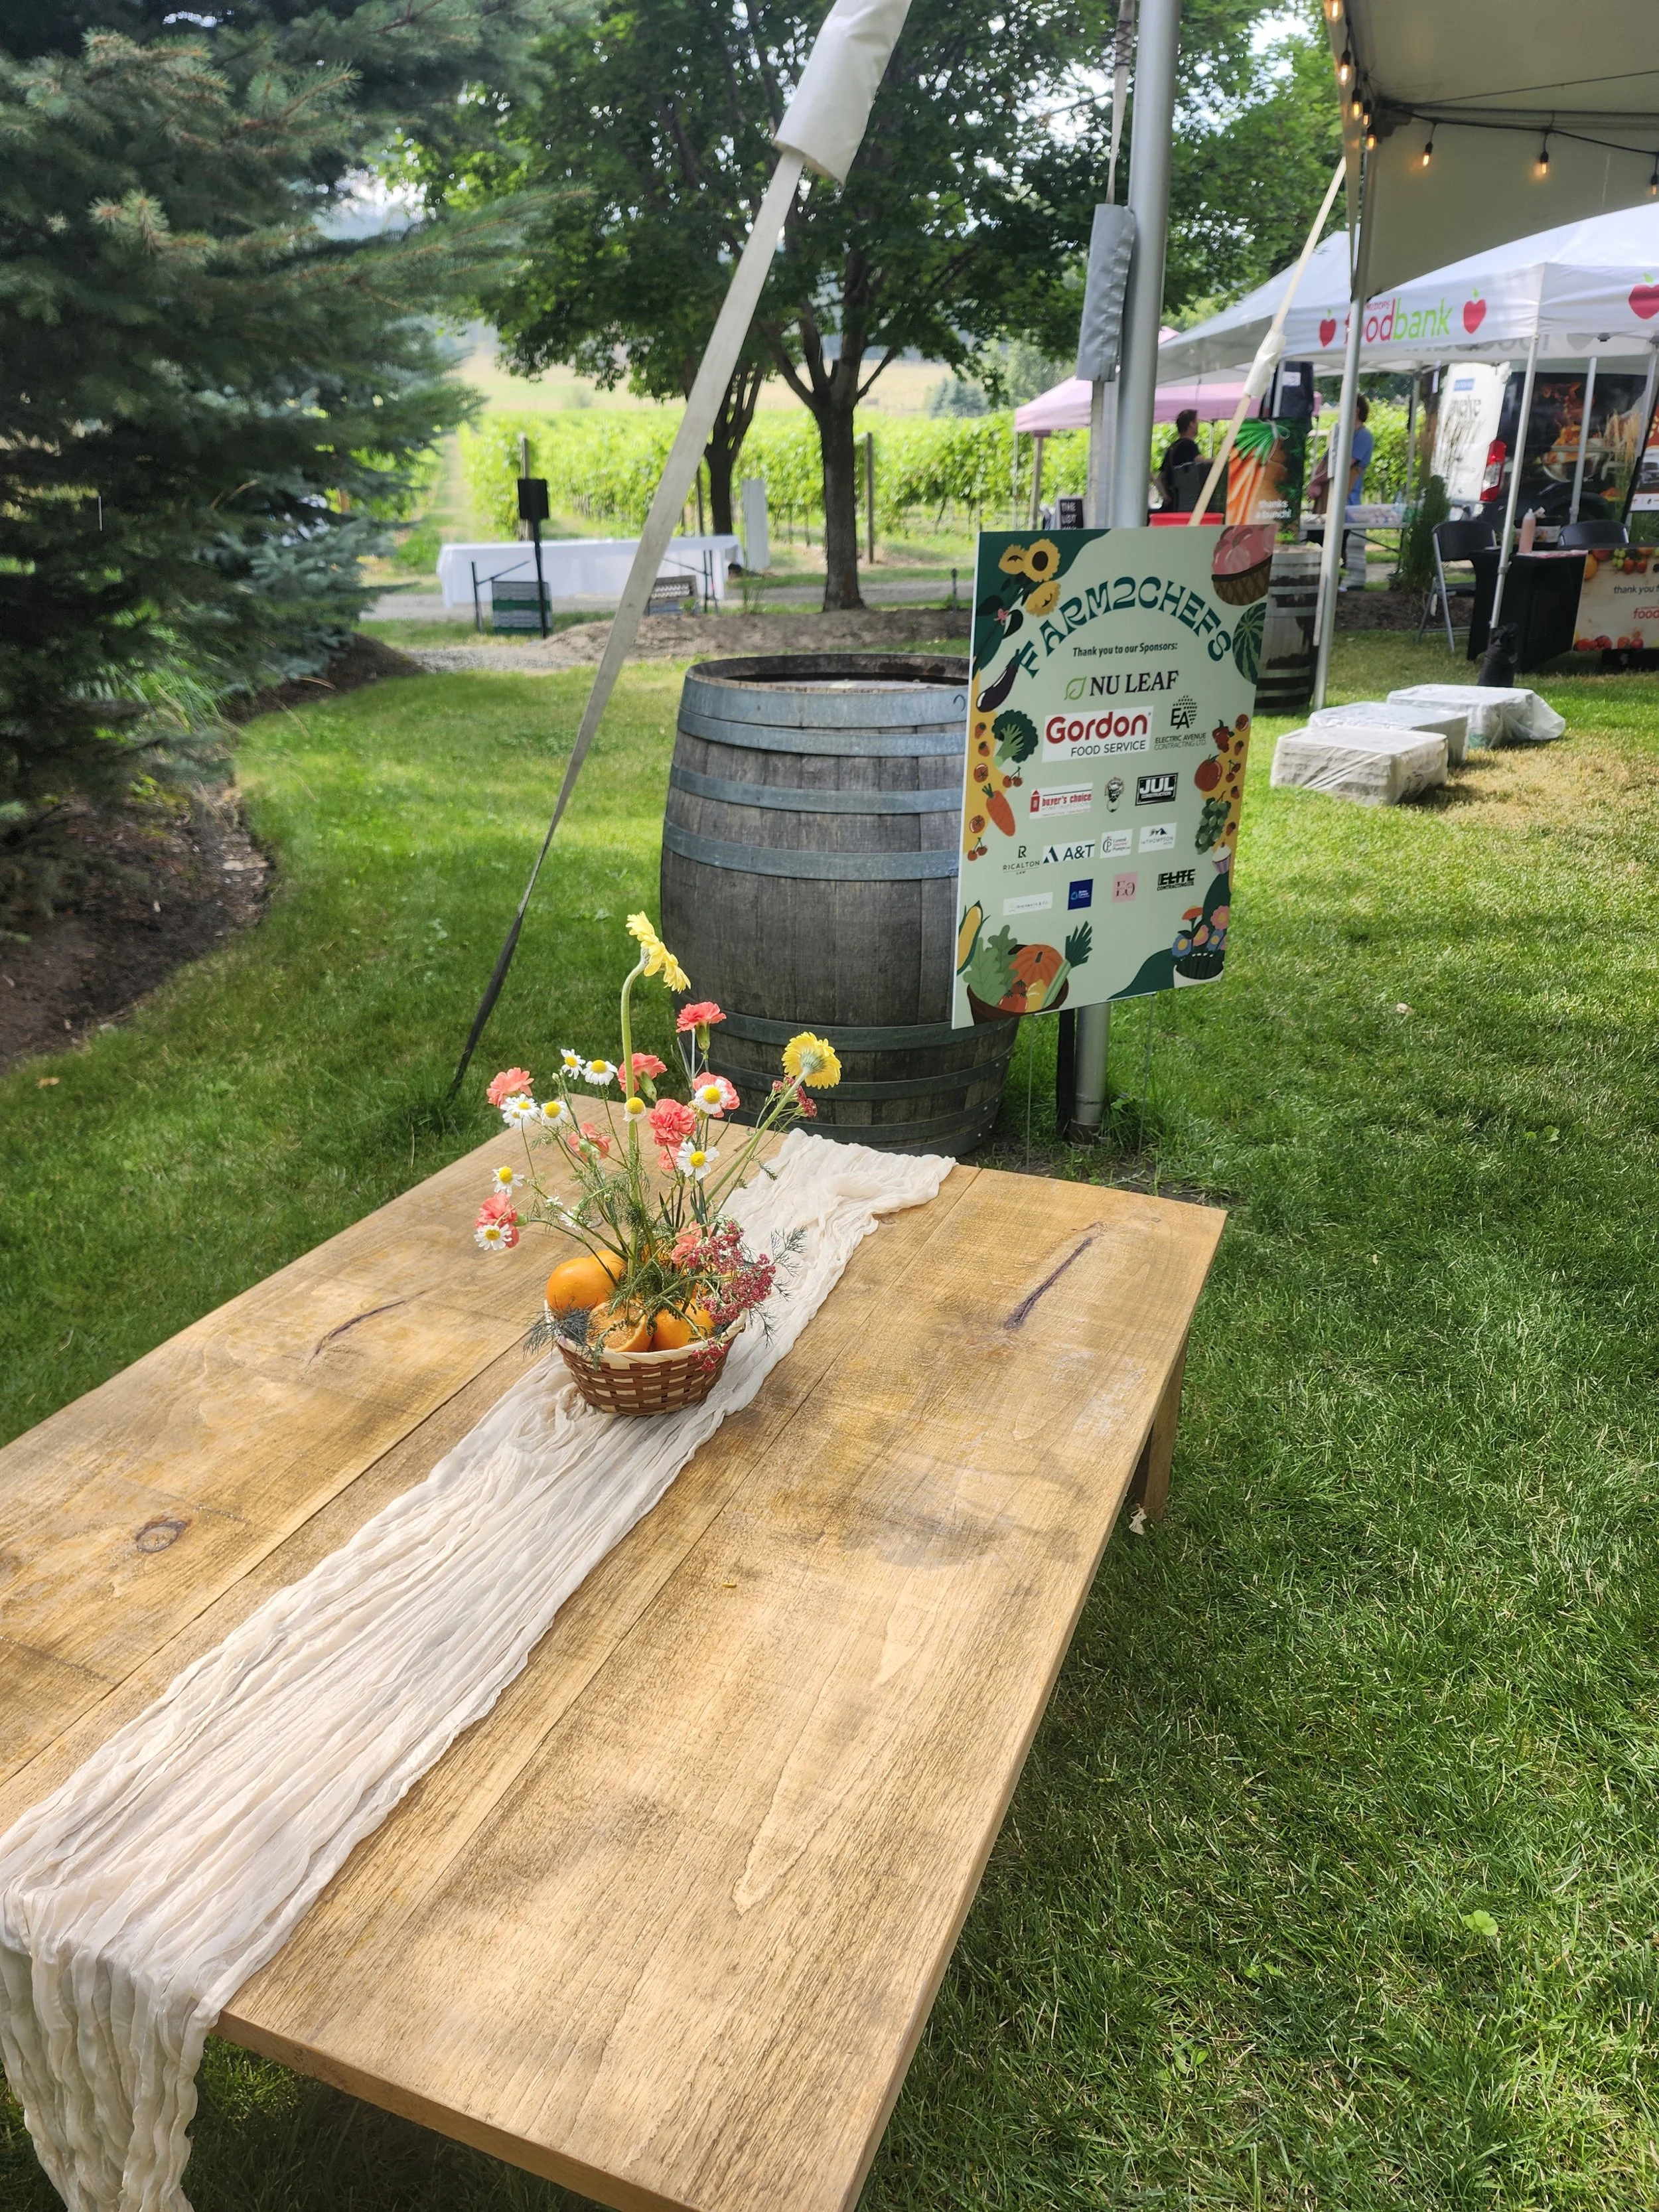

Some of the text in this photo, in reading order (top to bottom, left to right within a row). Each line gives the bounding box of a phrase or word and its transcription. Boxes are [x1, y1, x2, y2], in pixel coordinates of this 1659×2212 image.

[1614, 585, 1636, 594] thank
[1638, 586, 1654, 595] you
[1019, 576, 1231, 679] FARM2CHEFS
[1073, 646, 1097, 657] Thank
[1099, 646, 1113, 658] you
[1139, 642, 1178, 654] Sponsors:
[1090, 670, 1179, 696] NU LEAF
[1171, 707, 1190, 730] EA
[1046, 711, 1147, 744] Gordon
[1155, 735, 1182, 744] ELECTRIC
[1070, 740, 1146, 757] FOOD SERVICE
[1139, 777, 1174, 794] JUL
[1043, 794, 1092, 806] buyer's choice
[1062, 844, 1095, 861] A&T
[1003, 861, 1040, 871] RICALTON
